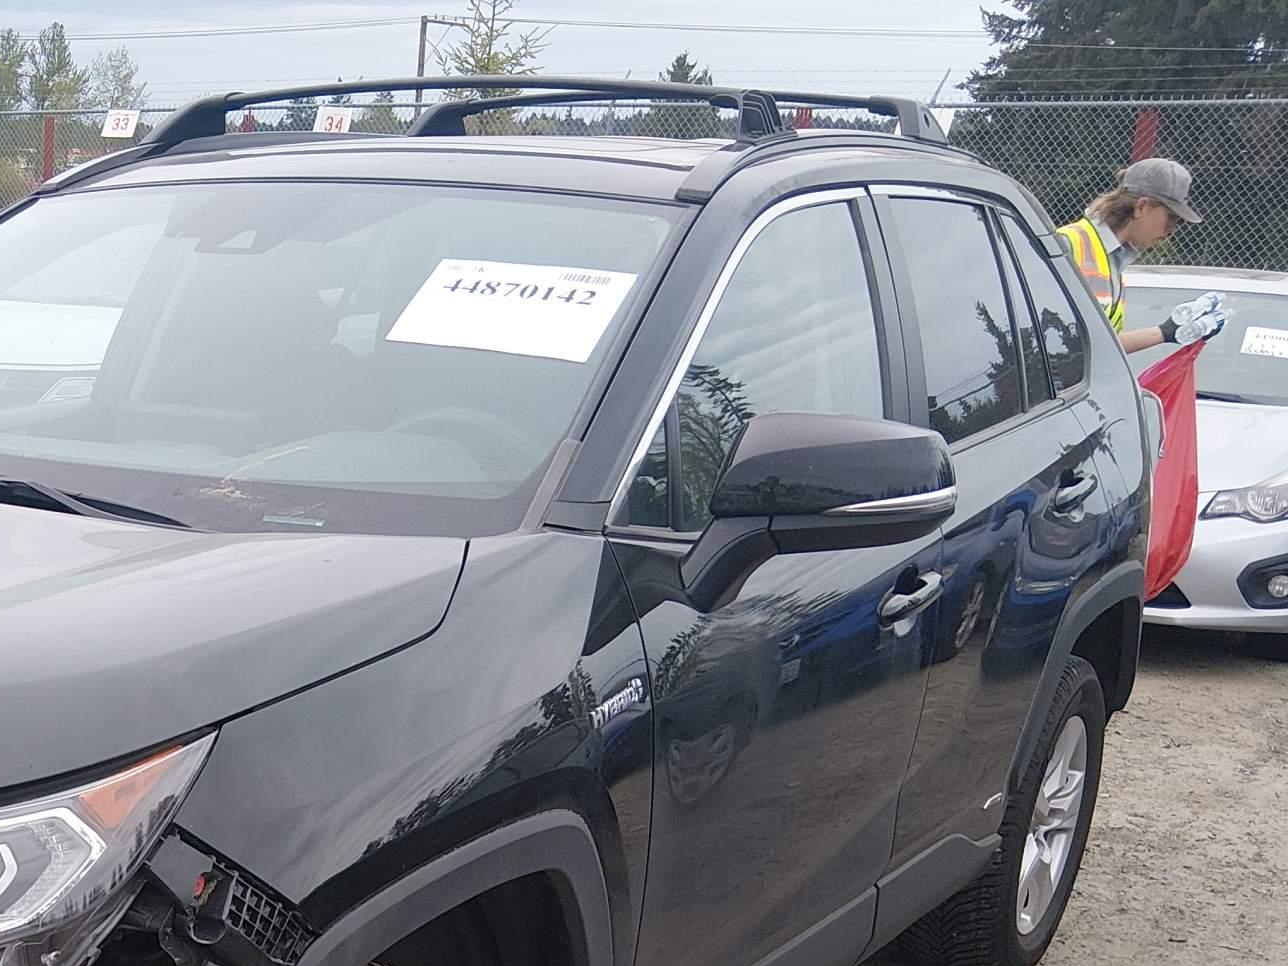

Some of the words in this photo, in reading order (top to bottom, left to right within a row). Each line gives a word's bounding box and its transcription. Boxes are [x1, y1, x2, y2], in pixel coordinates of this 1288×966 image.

[111, 116, 130, 131] 33
[324, 115, 344, 132] 34
[443, 277, 598, 306] 44870142
